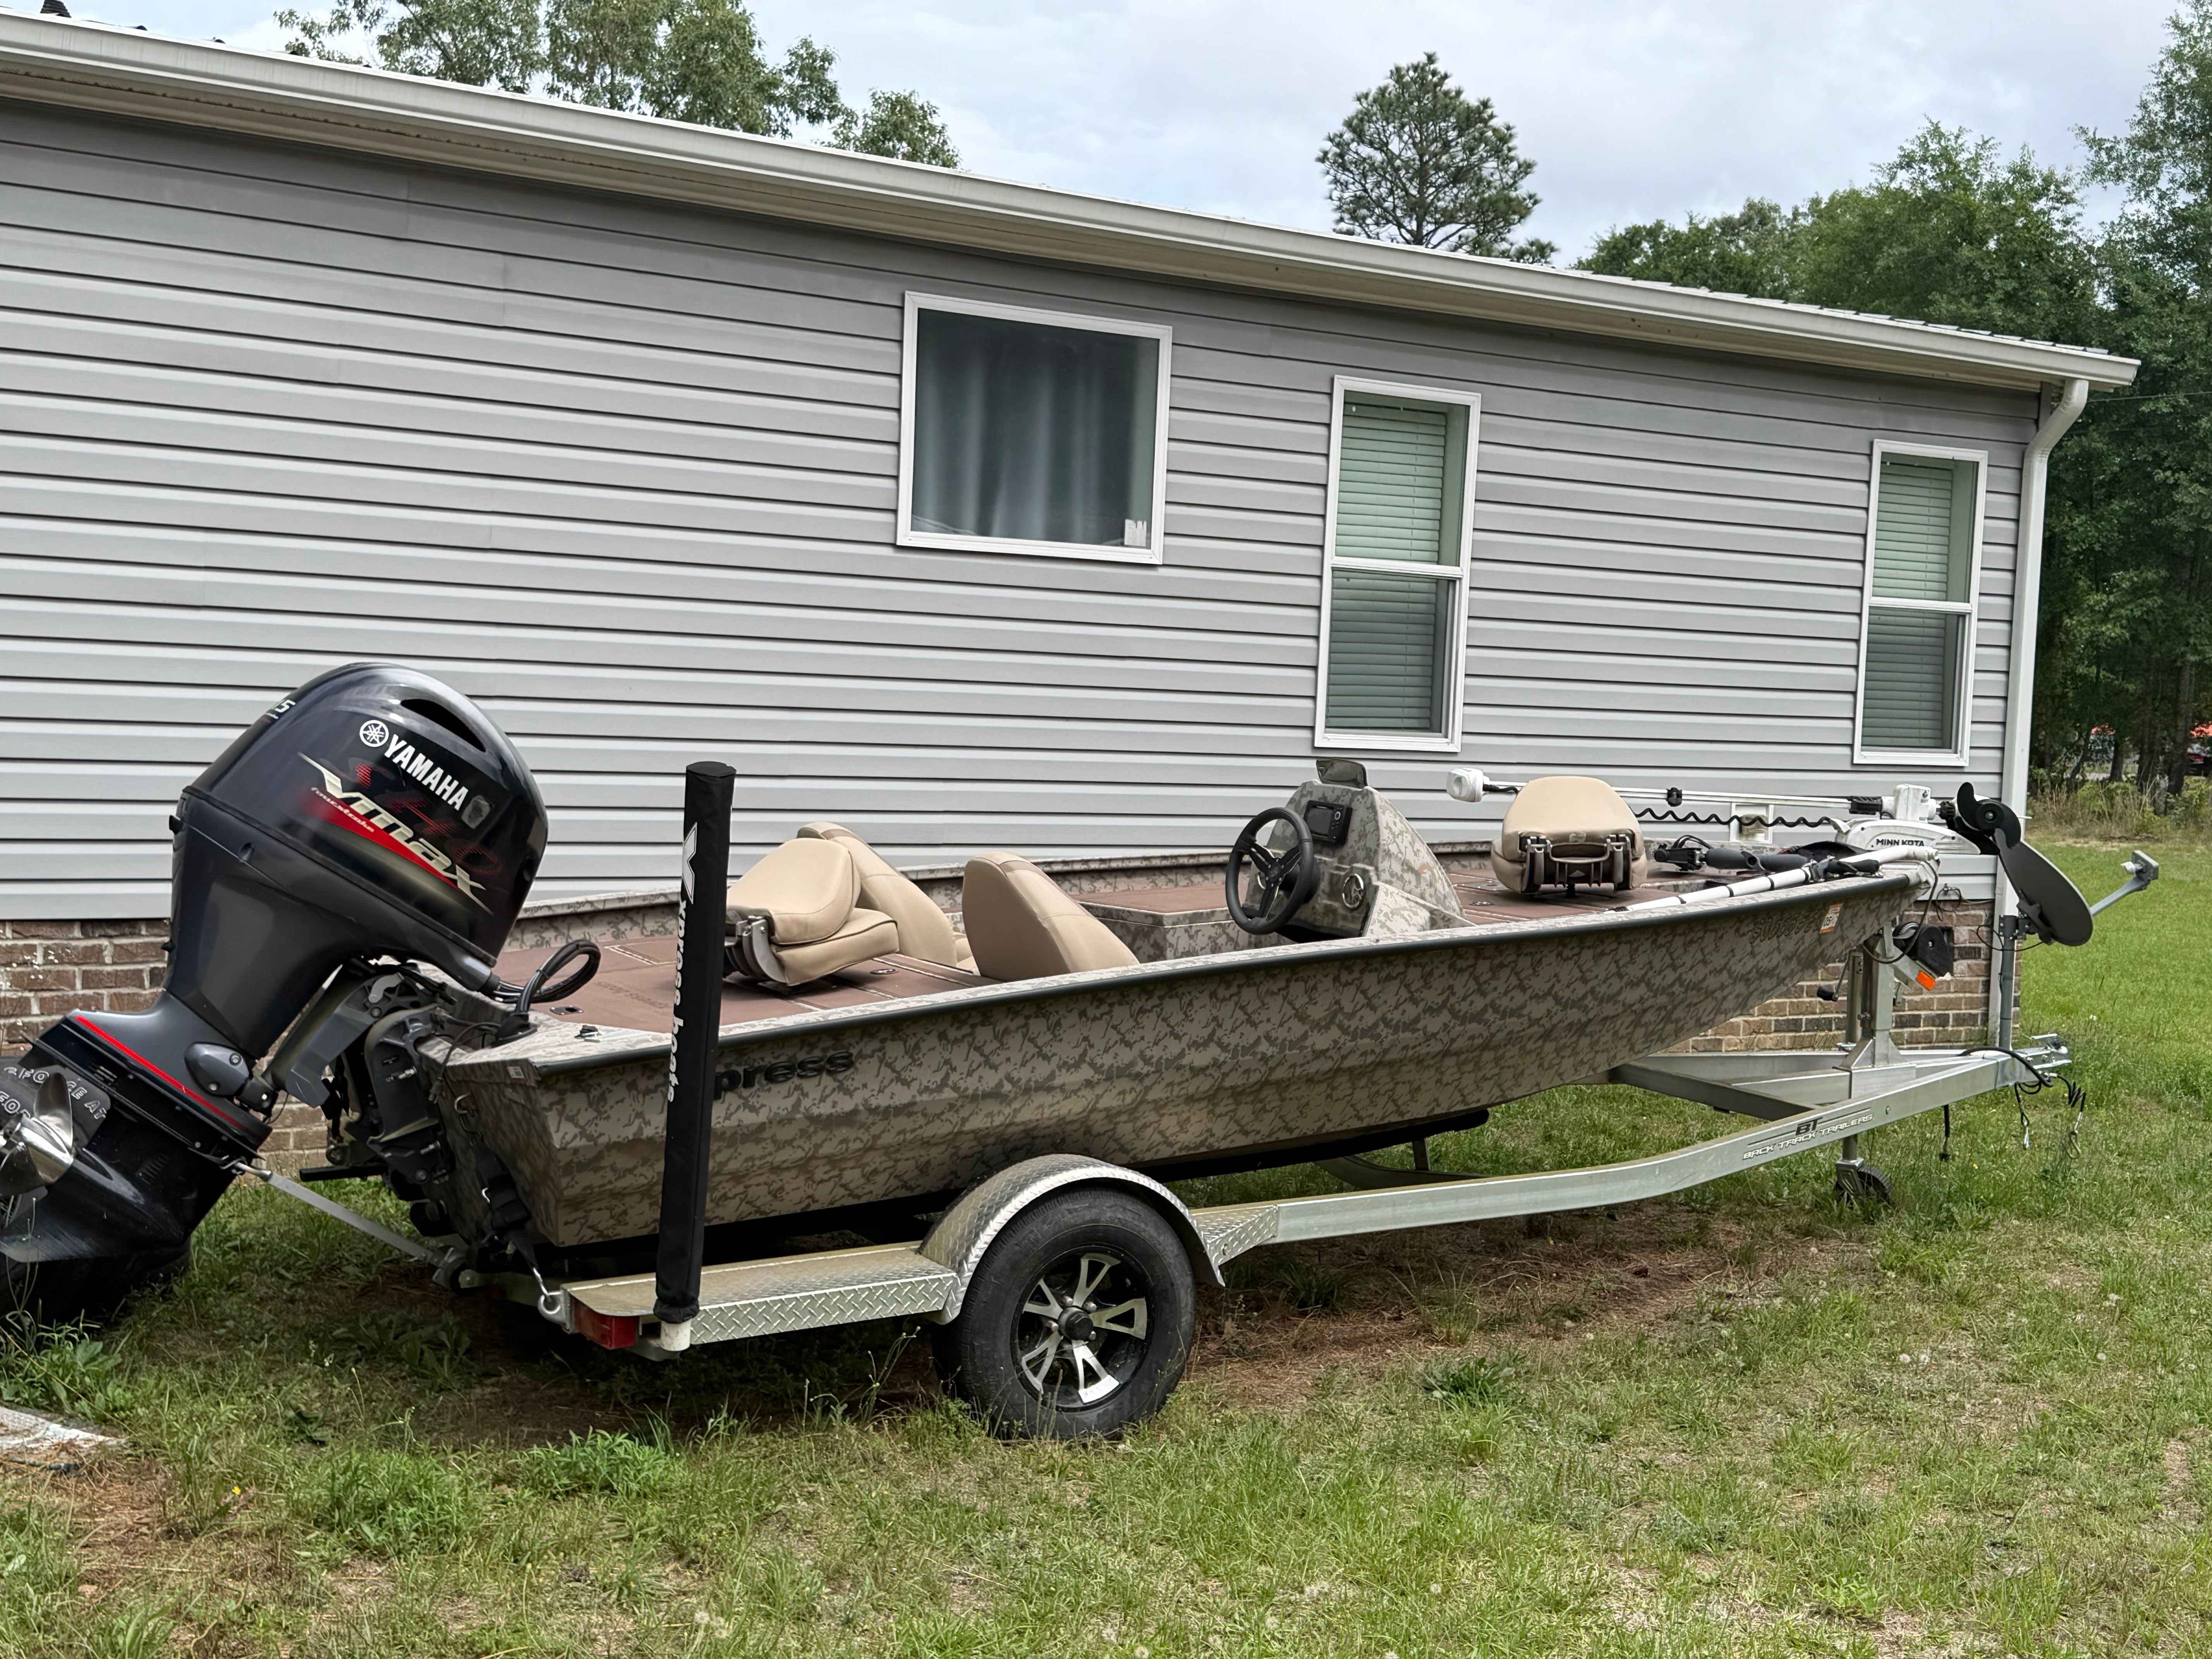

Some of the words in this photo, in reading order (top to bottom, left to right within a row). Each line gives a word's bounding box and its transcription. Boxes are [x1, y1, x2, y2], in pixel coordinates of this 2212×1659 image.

[384, 734, 469, 810] YAMAHA
[713, 1051, 854, 1101] press
[84, 1100, 107, 1120] AT
[1795, 1117, 1823, 1136] BT
[1743, 1144, 1776, 1160] BACK
[1778, 1130, 1817, 1150] TRACK
[1820, 1114, 1874, 1137] TRAILERS
